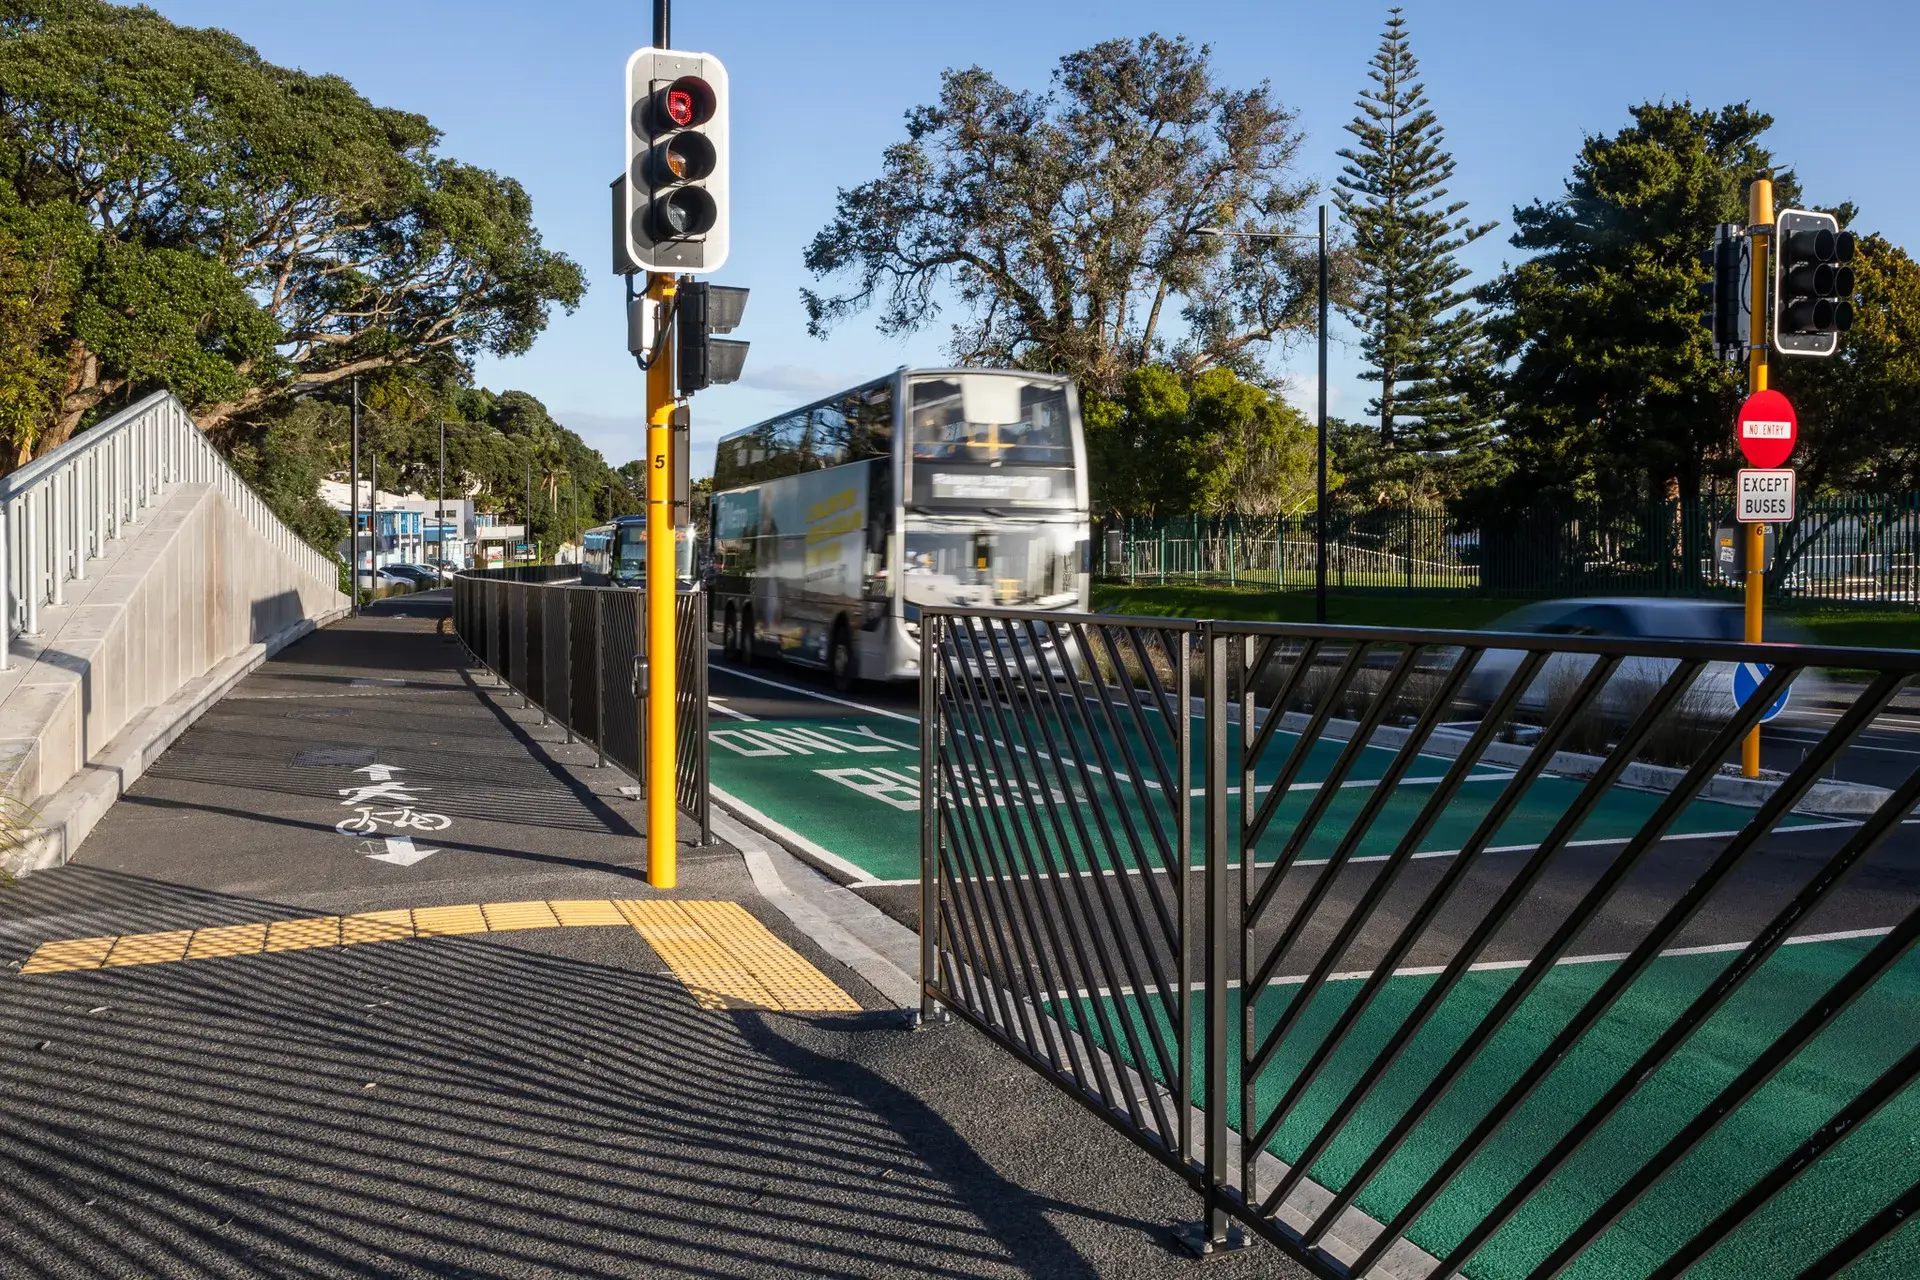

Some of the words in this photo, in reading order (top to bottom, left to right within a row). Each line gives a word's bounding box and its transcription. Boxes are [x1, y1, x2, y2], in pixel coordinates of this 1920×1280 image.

[670, 91, 691, 124] B
[1749, 424, 1758, 435] NO
[1762, 424, 1785, 436] ENTRY
[654, 454, 666, 469] 5
[1743, 477, 1789, 492] EXCEPT
[1745, 499, 1786, 514] BUSES
[1756, 526, 1763, 536] 6
[707, 725, 920, 758] ONLY
[812, 764, 1089, 811] BUS
